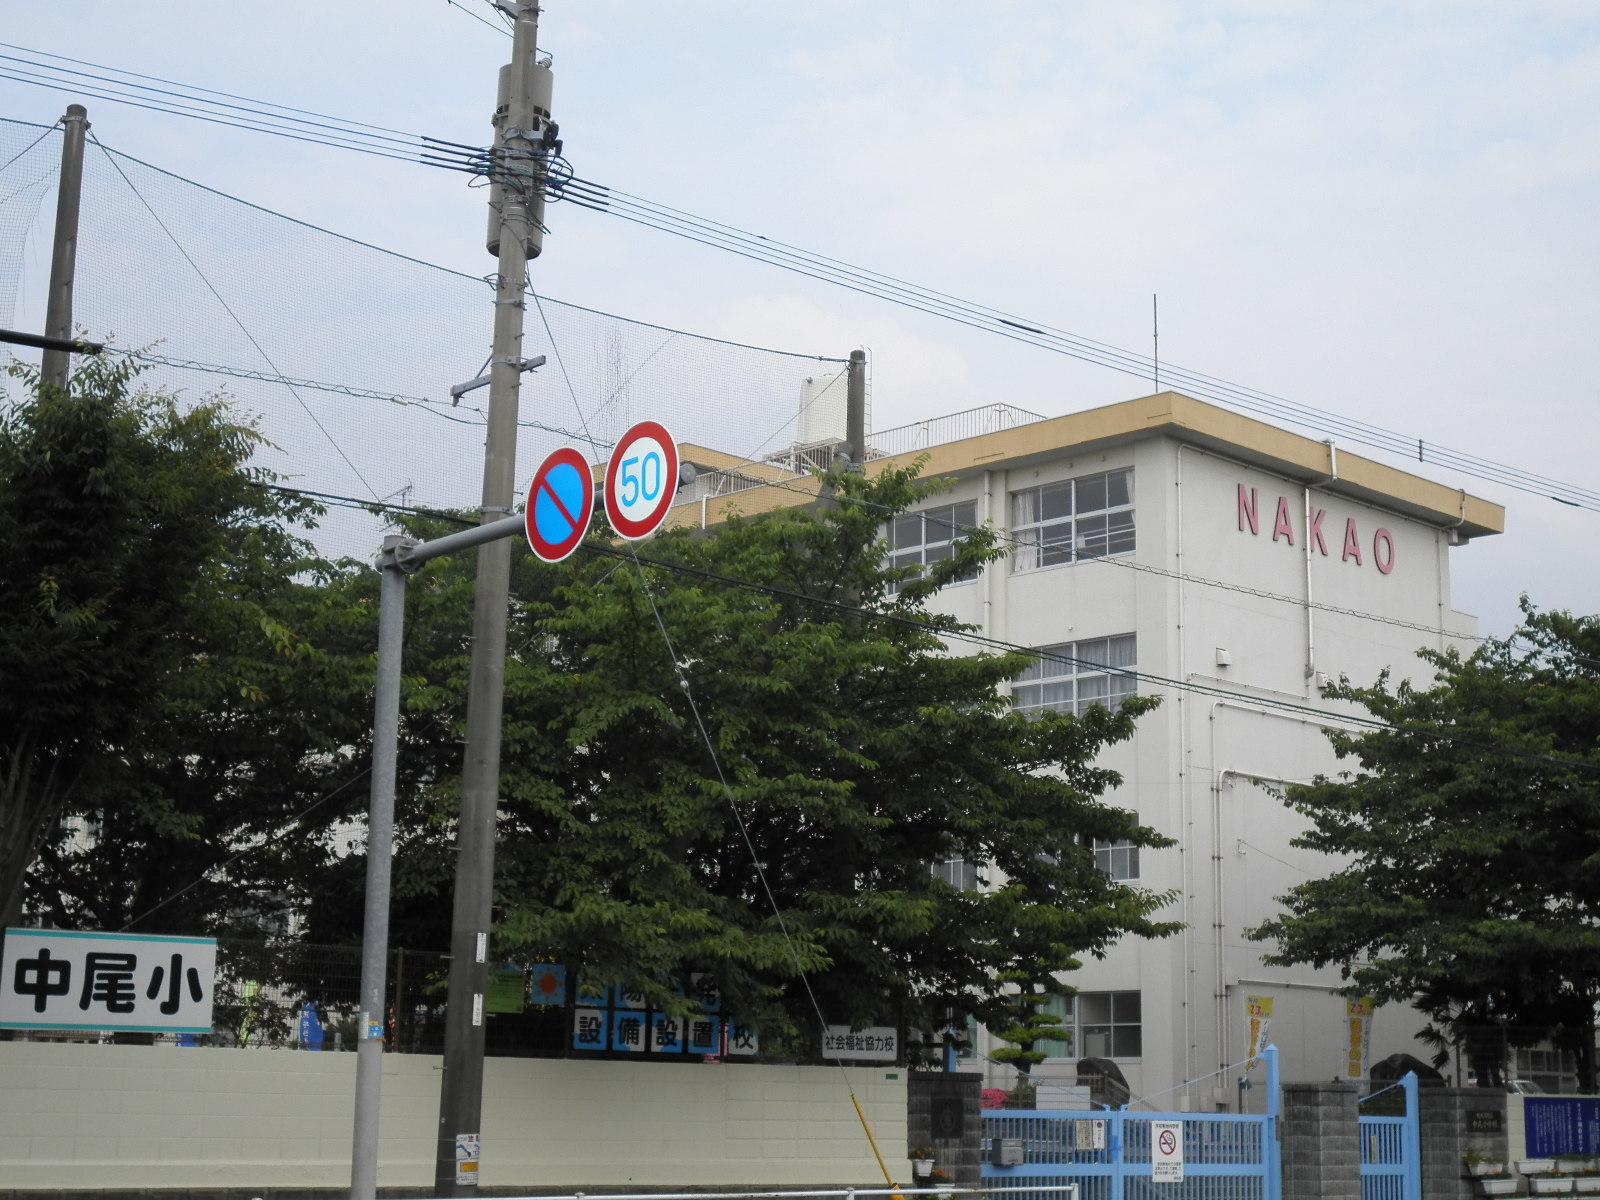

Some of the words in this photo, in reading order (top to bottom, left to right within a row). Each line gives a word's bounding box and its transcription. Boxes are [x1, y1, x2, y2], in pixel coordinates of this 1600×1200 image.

[621, 451, 661, 507] 50
[1238, 483, 1395, 575] NAKAO
[13, 947, 204, 1015] 中尾小
[578, 1016, 754, 1050] 設備設置校
[825, 1034, 895, 1052] 社会福祉協力校
